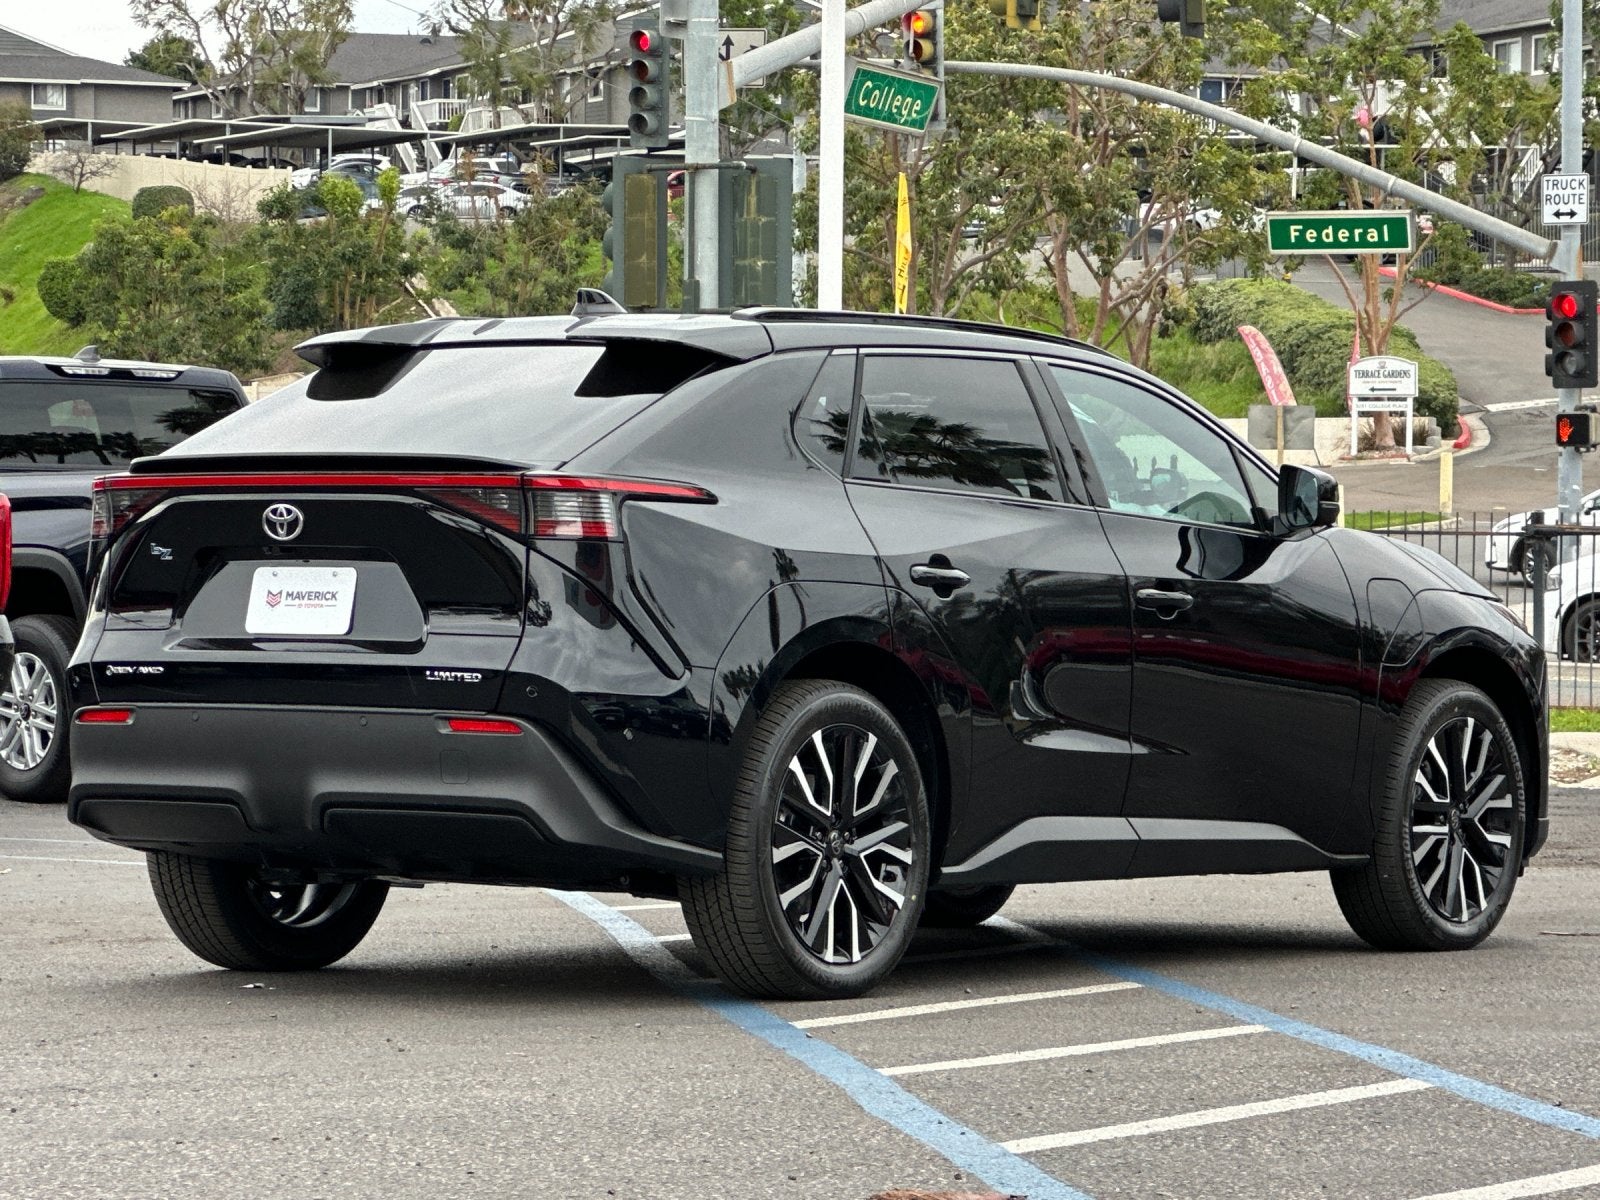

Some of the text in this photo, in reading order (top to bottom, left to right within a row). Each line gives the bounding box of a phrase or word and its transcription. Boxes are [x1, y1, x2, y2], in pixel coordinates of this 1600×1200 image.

[859, 80, 922, 124] College
[1545, 178, 1586, 190] TRUCK
[1544, 193, 1586, 206] ROUTE
[1290, 224, 1389, 243] Federal
[1354, 369, 1411, 379] TERRACE GARDENS
[285, 590, 339, 602] MAVERICK
[425, 670, 482, 682] LIMITED
